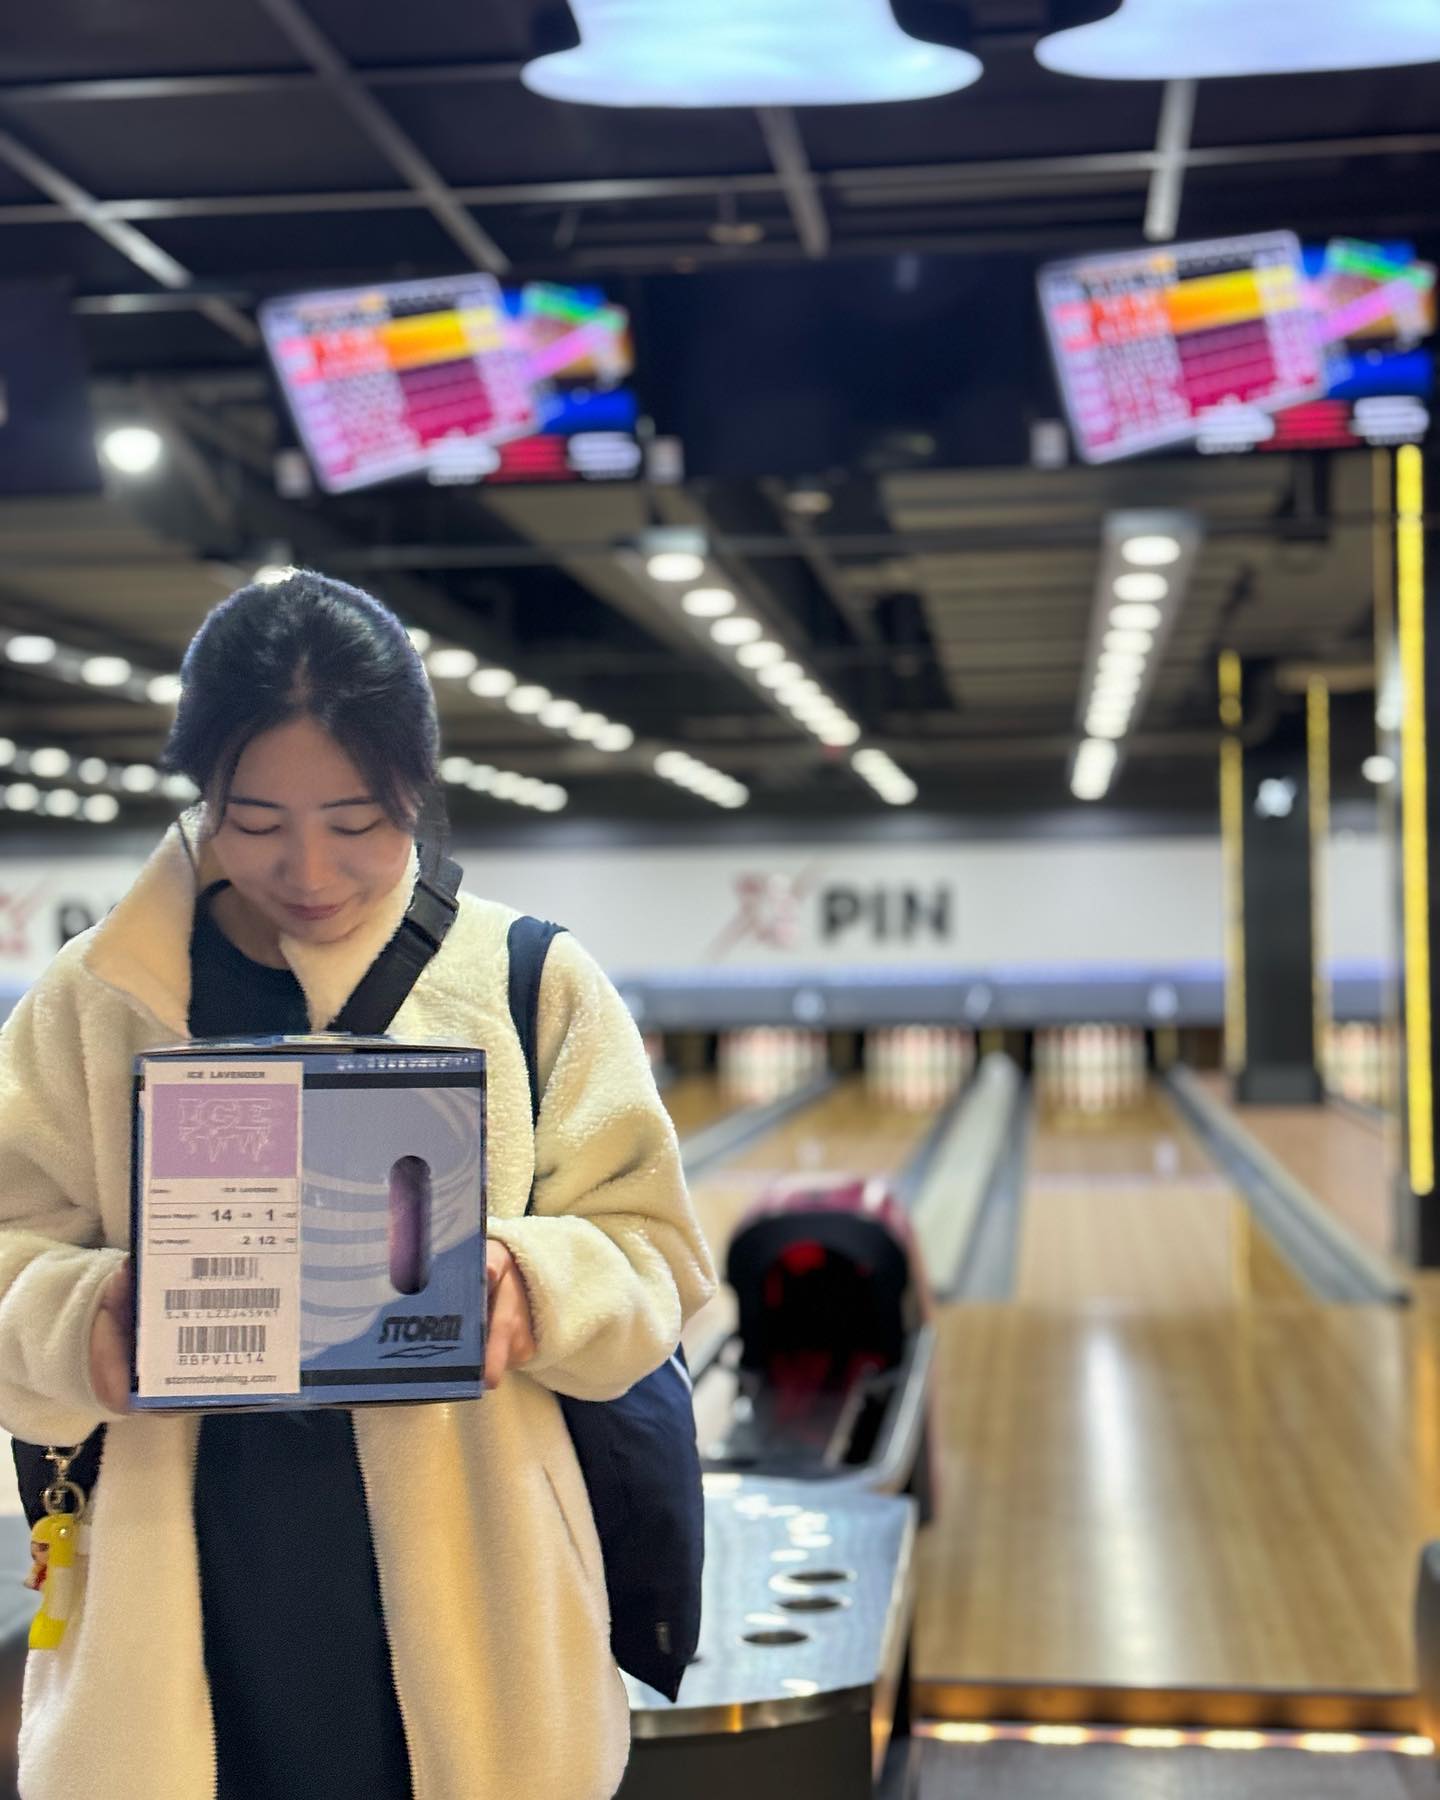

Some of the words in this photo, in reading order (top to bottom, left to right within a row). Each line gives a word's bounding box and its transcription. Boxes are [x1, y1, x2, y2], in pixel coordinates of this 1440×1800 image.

[820, 882, 954, 945] PIN
[187, 1071, 203, 1079] ICE
[210, 1071, 265, 1079] LAVENDER
[211, 1209, 233, 1221] 14
[265, 1208, 274, 1221] 1
[241, 1235, 251, 1245] 2
[378, 1315, 463, 1343] STORM
